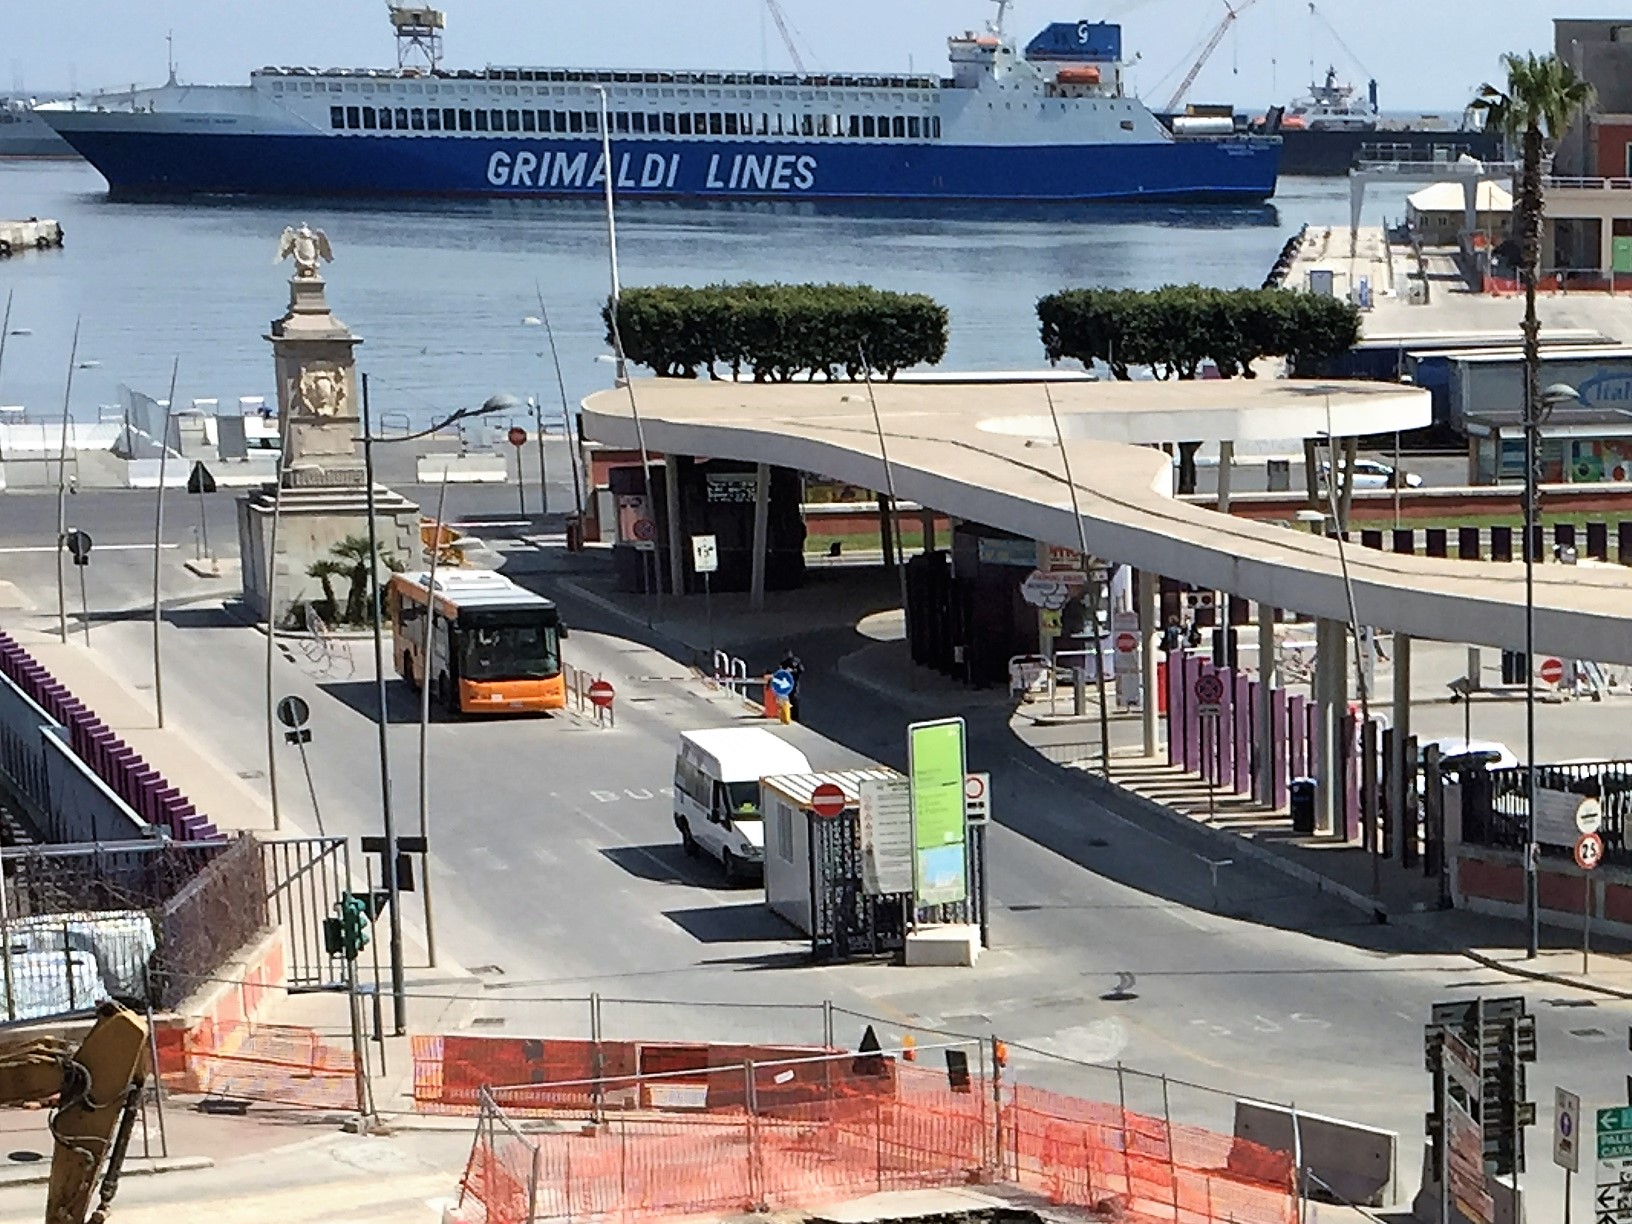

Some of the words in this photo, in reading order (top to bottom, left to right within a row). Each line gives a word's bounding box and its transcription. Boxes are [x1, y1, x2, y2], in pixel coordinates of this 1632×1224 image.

[486, 150, 681, 187] GRIMALDI
[705, 153, 818, 190] LINES
[1582, 842, 1597, 859] 25
